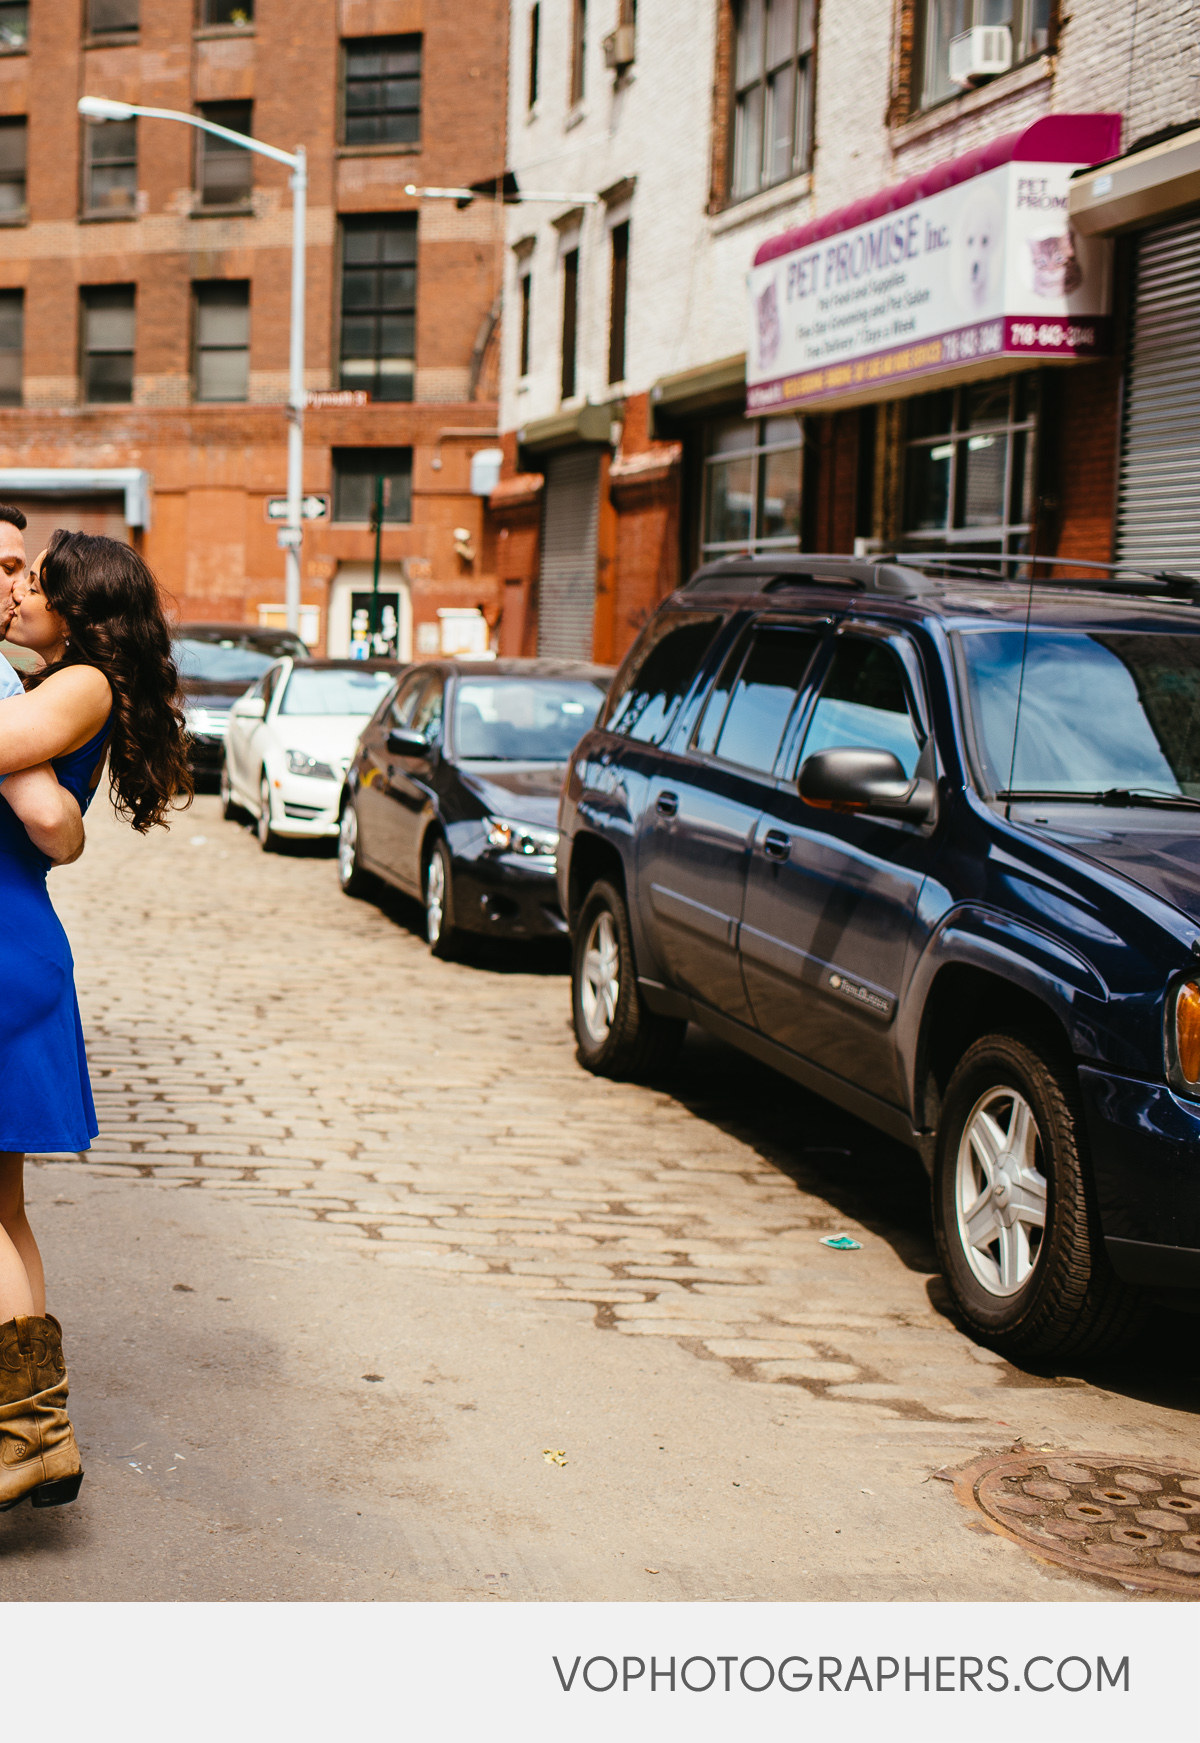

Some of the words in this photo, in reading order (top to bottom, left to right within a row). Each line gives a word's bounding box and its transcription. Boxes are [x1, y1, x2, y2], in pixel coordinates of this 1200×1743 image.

[1017, 179, 1048, 193] PET
[787, 254, 820, 302] PET
[824, 213, 919, 287] PROMISE
[924, 219, 950, 252] Inc.
